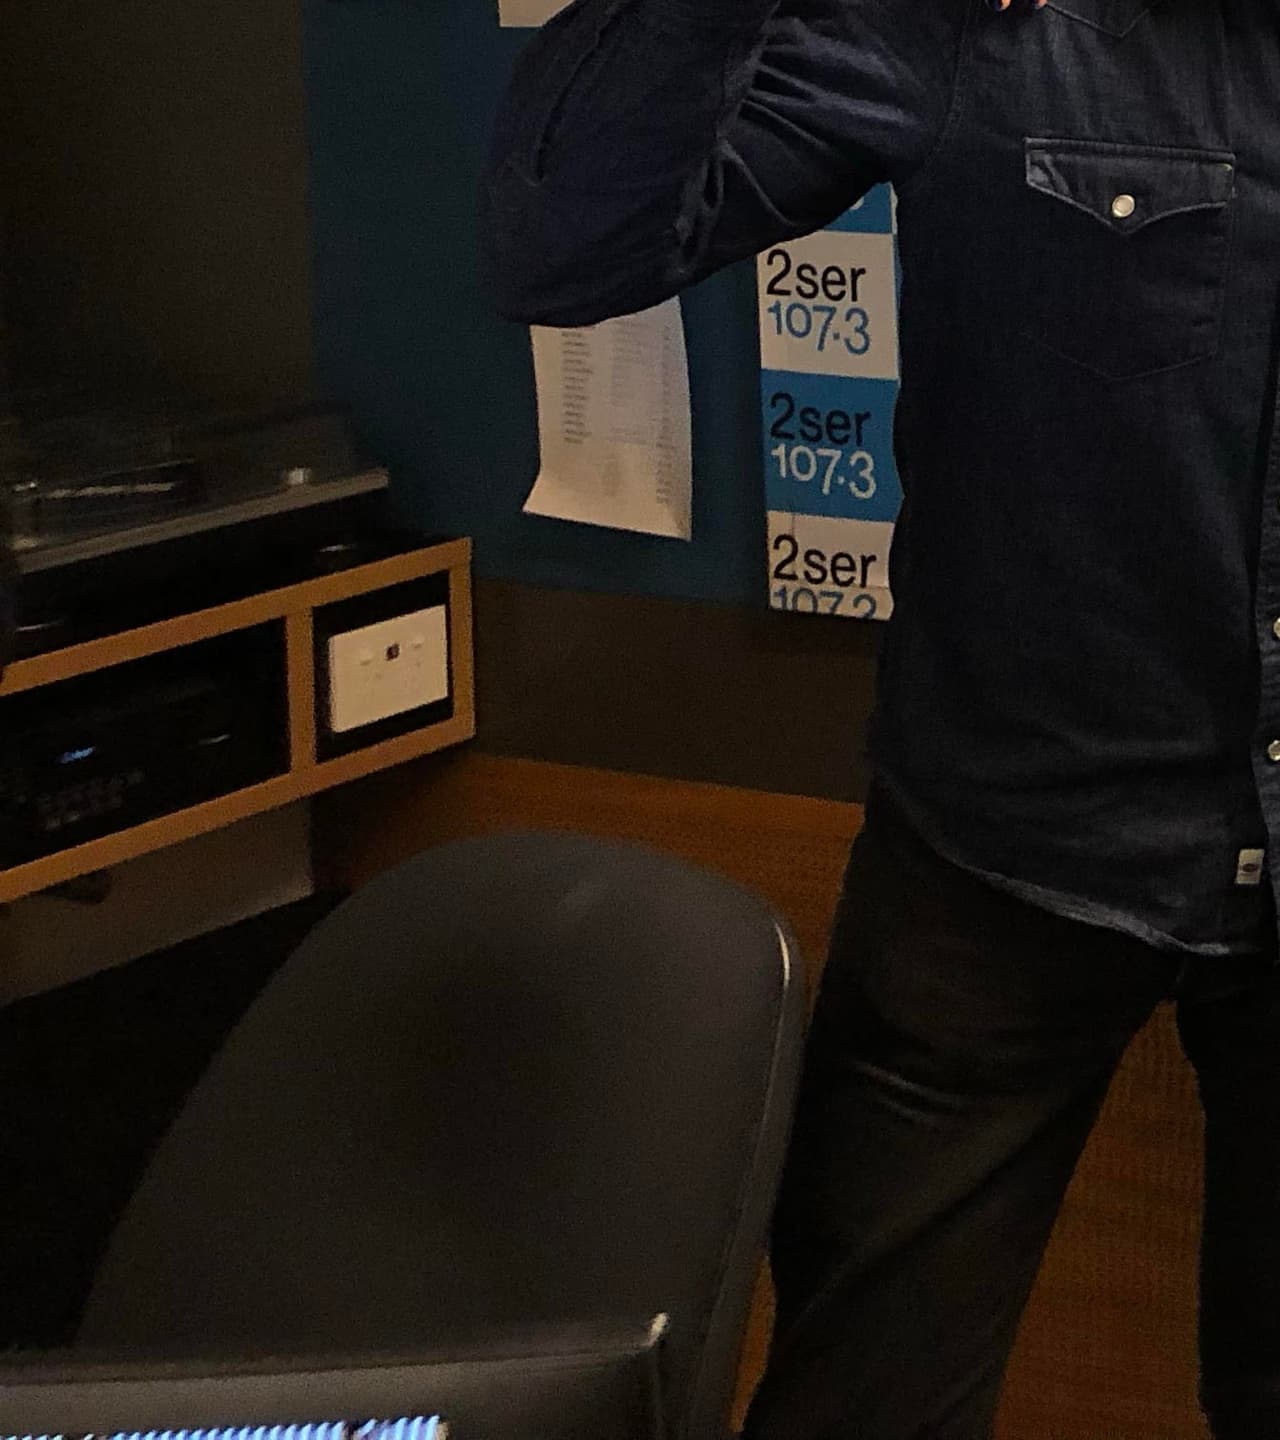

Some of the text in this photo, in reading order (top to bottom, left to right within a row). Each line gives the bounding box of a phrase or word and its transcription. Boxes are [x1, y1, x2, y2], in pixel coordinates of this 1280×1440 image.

[766, 249, 866, 302] 2ser
[767, 300, 871, 355] 107.3
[769, 392, 872, 446] 2ser
[770, 444, 877, 499] 107.3
[773, 534, 877, 588] 2ser
